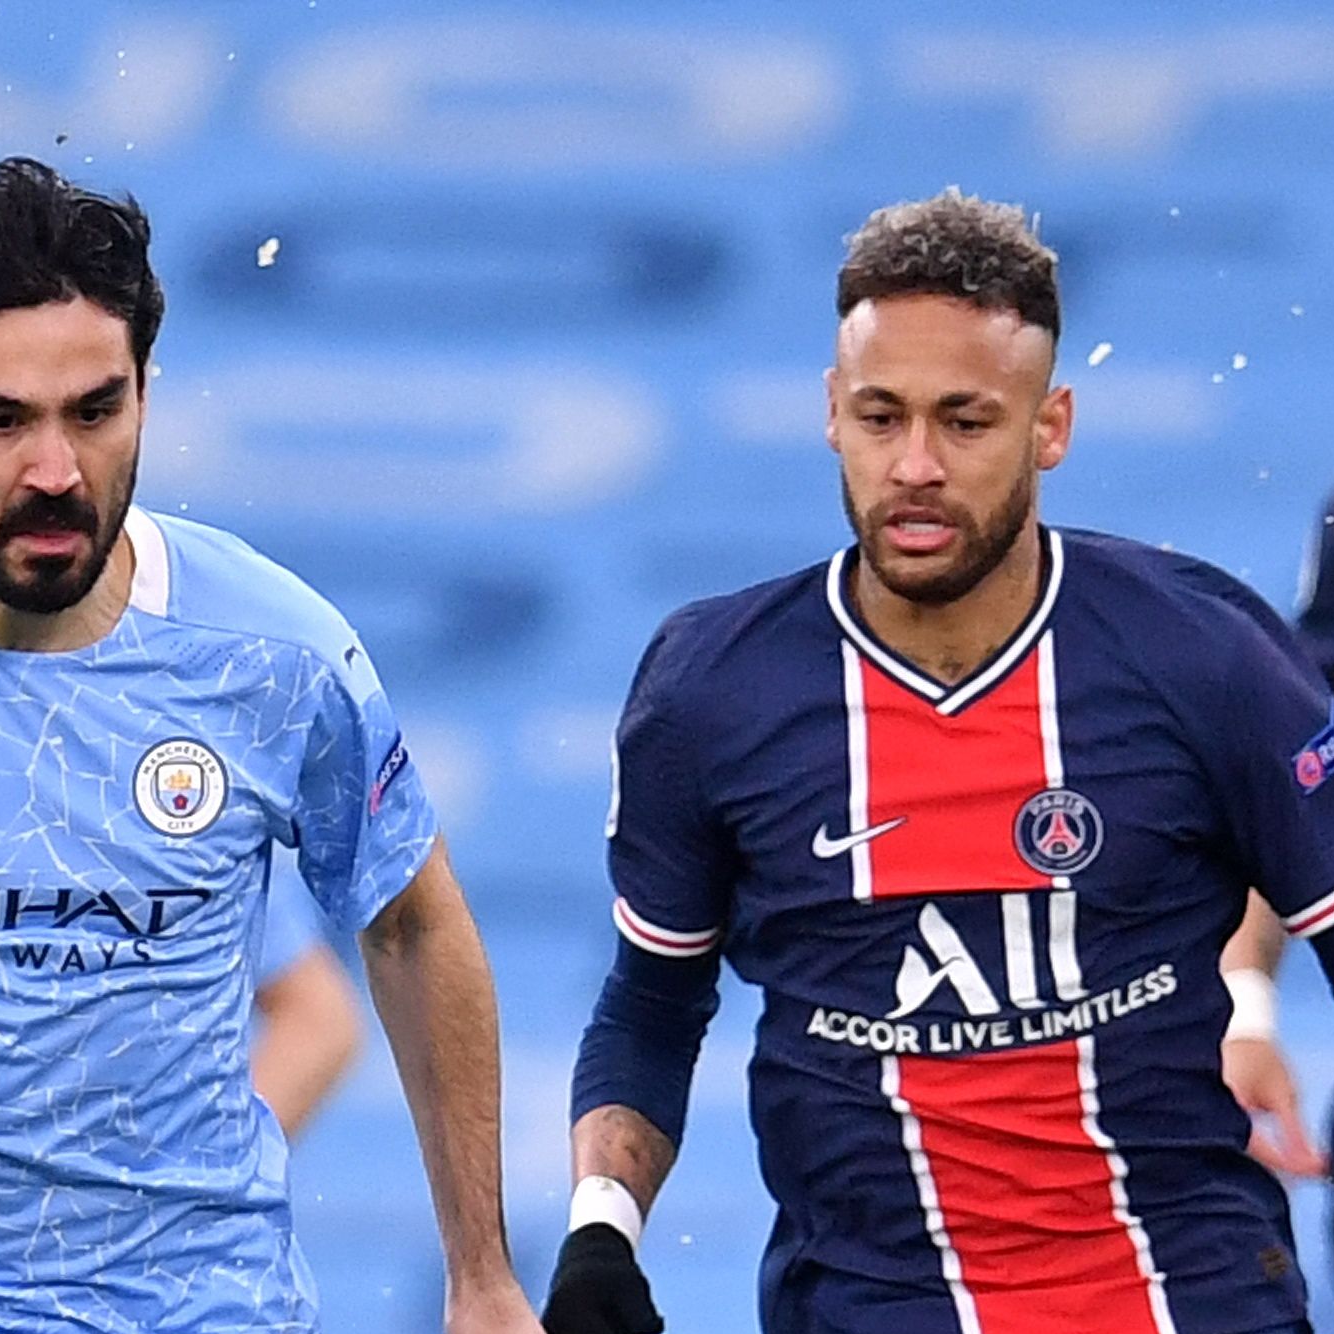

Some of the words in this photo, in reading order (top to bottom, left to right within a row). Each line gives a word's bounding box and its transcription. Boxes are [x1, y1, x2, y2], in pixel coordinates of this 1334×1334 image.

[807, 1006, 920, 1054] ACCOR
[929, 1020, 1014, 1053] LIVE
[1021, 963, 1178, 1039] LIMITLESS
